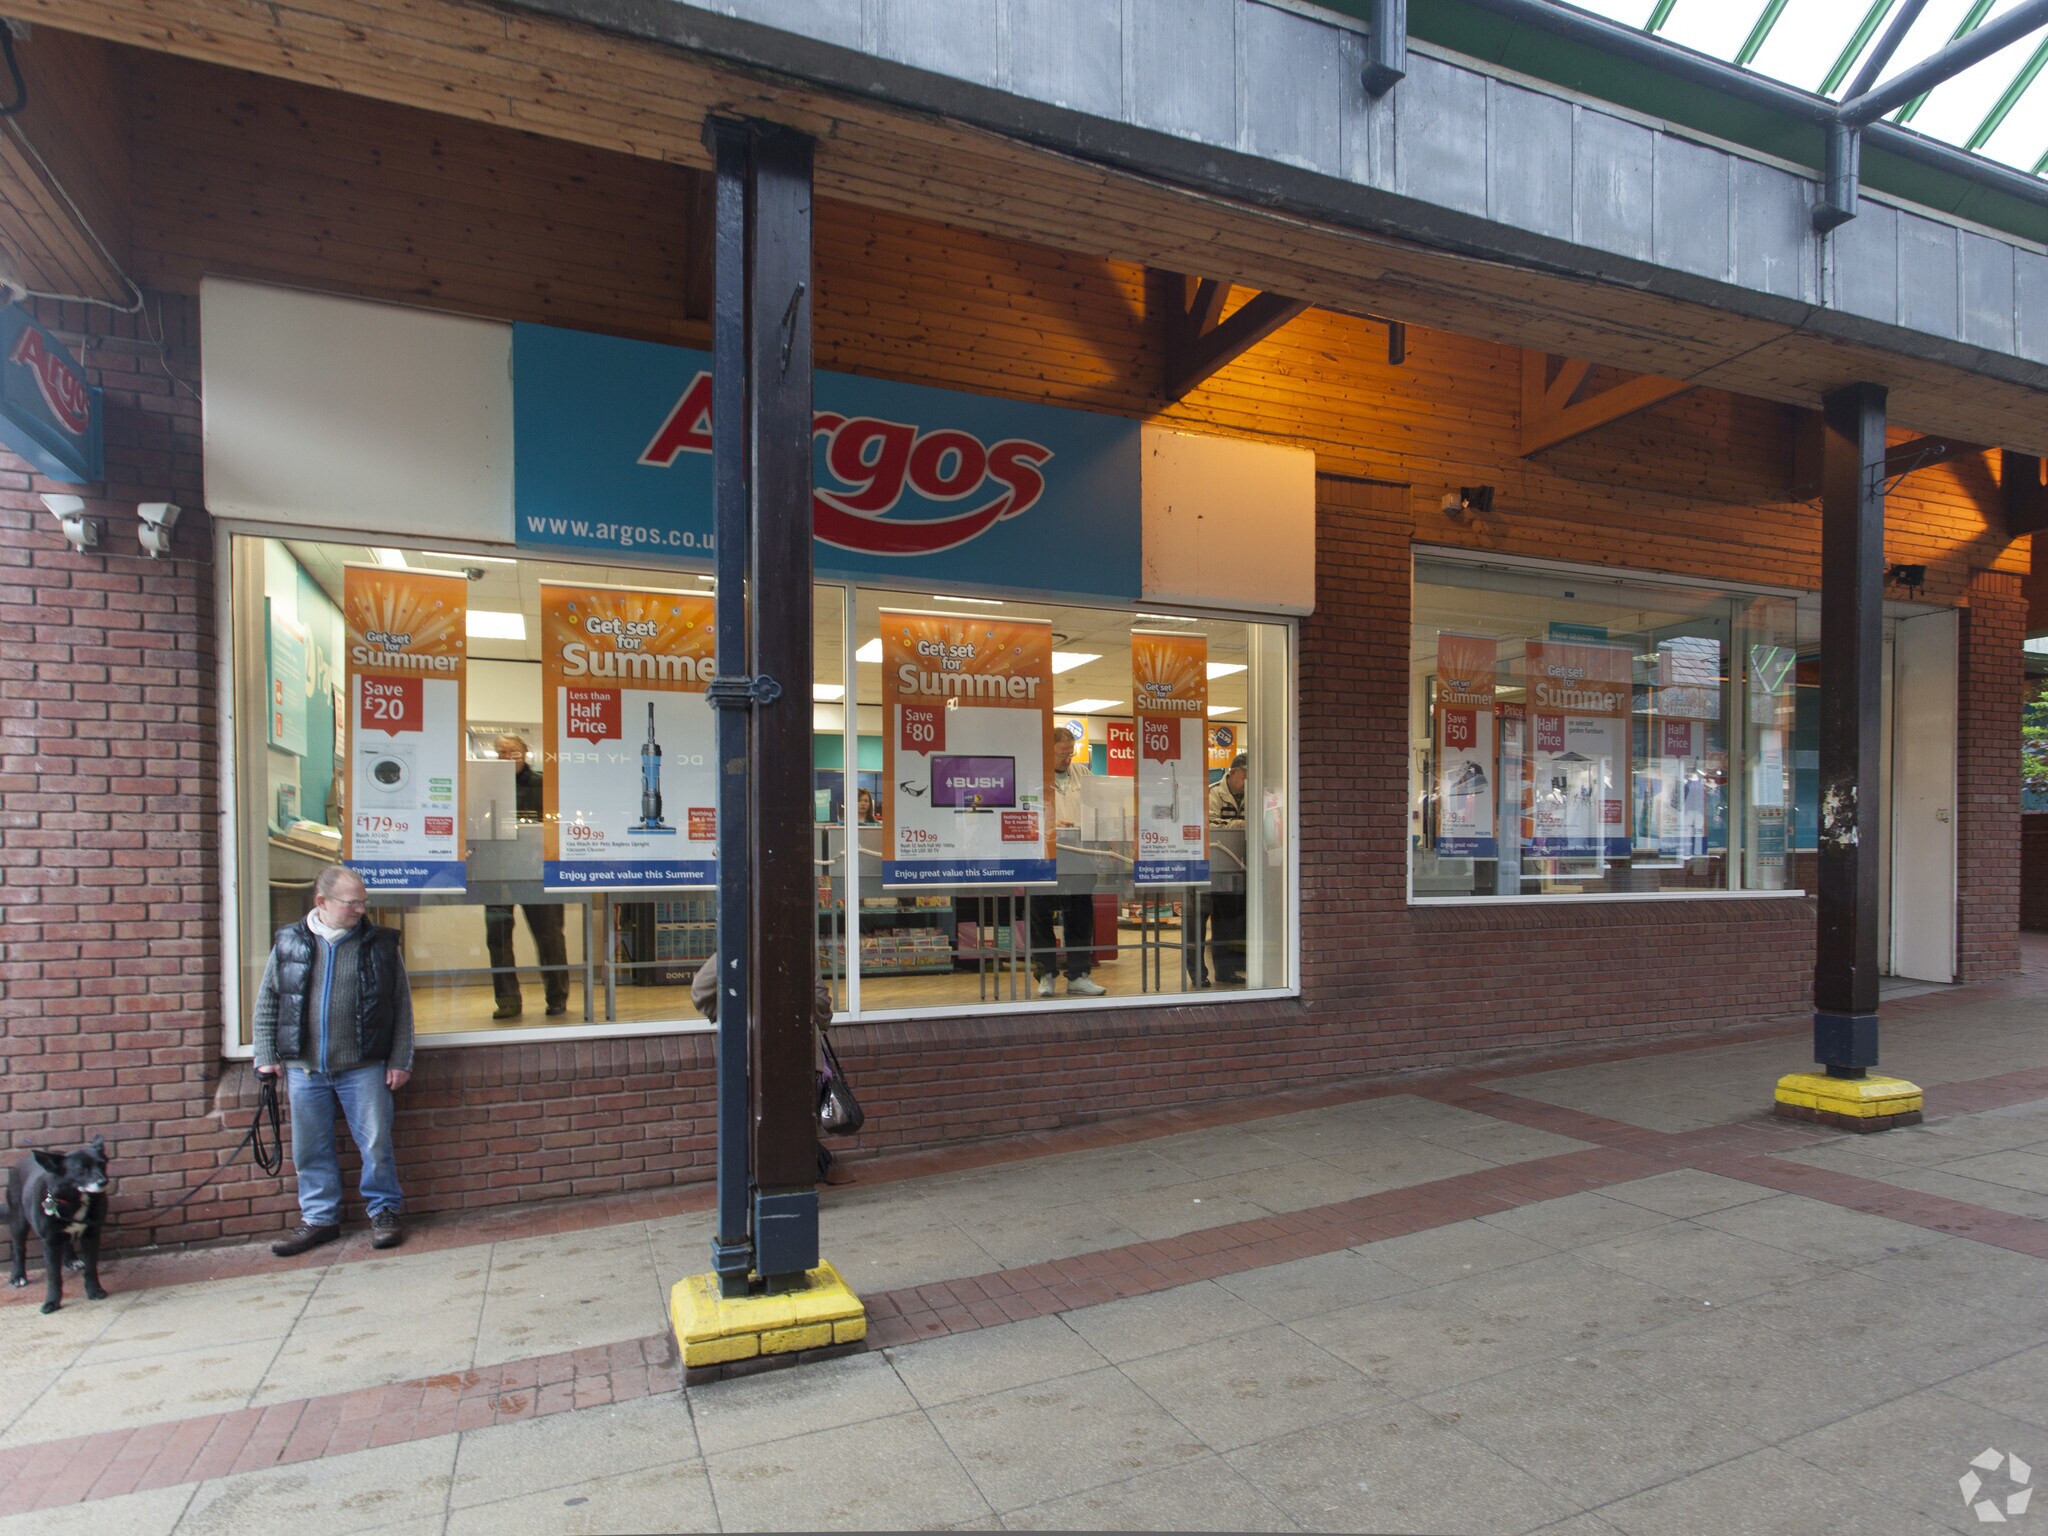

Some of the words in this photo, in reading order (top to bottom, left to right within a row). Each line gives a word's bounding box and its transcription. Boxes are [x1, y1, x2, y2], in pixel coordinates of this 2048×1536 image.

[527, 516, 715, 549] www.argos.co.u
[585, 616, 621, 635] Get
[623, 619, 657, 637] set
[366, 631, 389, 643] Get
[391, 634, 411, 645] set
[616, 634, 642, 650] for
[384, 642, 401, 651] for
[917, 640, 945, 656] Get
[947, 643, 975, 658] set
[352, 646, 459, 671] Summer
[562, 643, 715, 682] Summe
[941, 656, 962, 670] for
[1547, 665, 1566, 677] Get
[1567, 666, 1585, 678] set
[898, 664, 1040, 699] Summer
[1145, 682, 1159, 693] Get
[1160, 683, 1173, 693] set
[1449, 679, 1459, 687] Get
[1460, 680, 1470, 688] set
[1562, 677, 1576, 688] for
[364, 681, 403, 696] Save
[1156, 690, 1167, 699] for
[569, 691, 588, 700] Less
[591, 691, 611, 701] than
[1441, 690, 1493, 705] Summer
[1536, 683, 1625, 711] Summer
[364, 697, 404, 720] £20
[1137, 695, 1203, 712] Summer
[570, 703, 601, 718] Half
[905, 709, 933, 722] Save
[1447, 713, 1467, 724] Save
[1537, 718, 1558, 731] Half
[570, 719, 607, 734] Price
[906, 722, 935, 742] £80
[1144, 721, 1169, 733] Save
[1447, 724, 1467, 740] £50
[1667, 724, 1686, 735] Half
[1145, 733, 1169, 751] £60
[1537, 733, 1562, 746] Price
[1667, 738, 1689, 749] Price
[953, 777, 1004, 788] BUSH
[357, 816, 409, 832] £179.99
[567, 826, 605, 840] £99.99
[900, 829, 938, 842] £219.99
[1141, 831, 1169, 844] £99.99
[379, 867, 404, 876] great
[405, 867, 429, 876] value
[559, 870, 587, 882] Enjoy
[589, 871, 615, 881] great
[617, 870, 644, 880] value
[645, 869, 664, 879] this
[665, 869, 705, 879] Summer
[894, 870, 917, 880] Enjoy
[919, 870, 941, 880] great
[942, 869, 964, 877] value
[965, 868, 981, 877] this
[982, 868, 1015, 877] Summer
[1138, 865, 1155, 873] Enjoy
[371, 876, 409, 885] Summer
[665, 971, 692, 979] DON'T
